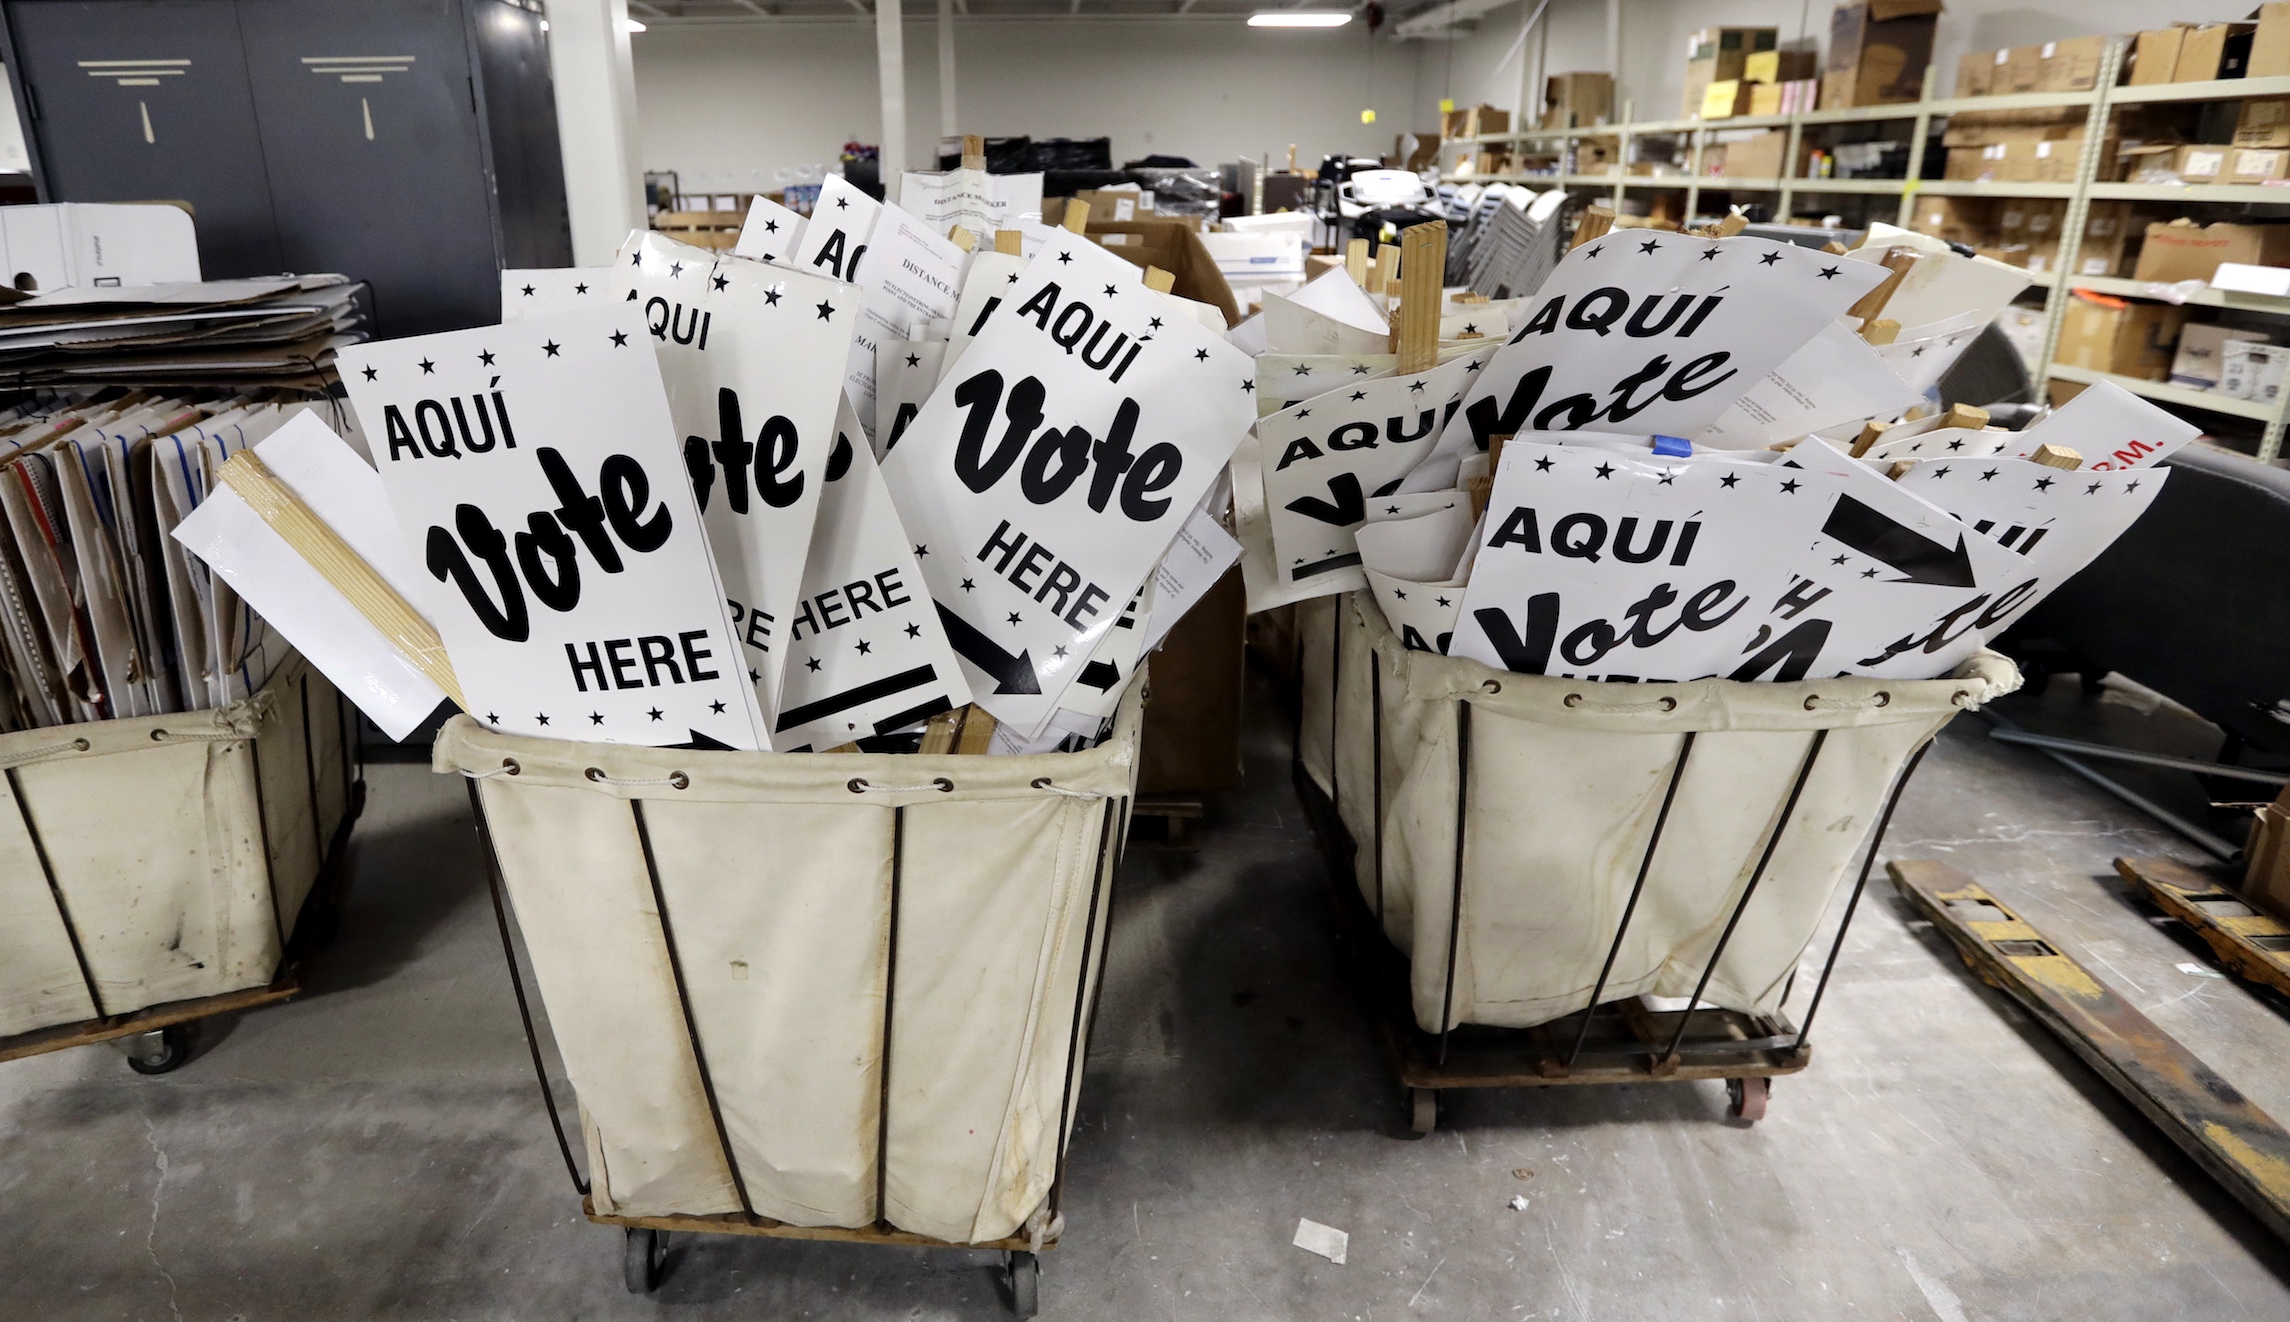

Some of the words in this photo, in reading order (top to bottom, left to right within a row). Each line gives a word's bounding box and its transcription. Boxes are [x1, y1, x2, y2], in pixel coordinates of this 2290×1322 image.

[934, 192, 973, 205] DISTANCE
[974, 194, 1007, 208] MARKER
[902, 259, 950, 295] DISTANCE
[1507, 285, 1730, 346] AQUÍ
[1016, 281, 1153, 384] AQUÍ
[384, 375, 517, 461] AQUÍ
[1466, 351, 1738, 451] Vote
[684, 387, 804, 515] te
[954, 369, 1183, 522] Vote
[426, 447, 672, 642] Vote
[977, 519, 1110, 634] HERE
[1487, 507, 1703, 566] AQUÍ
[726, 598, 775, 653] RE
[791, 567, 912, 641] HERE
[1474, 580, 1749, 675] Vote
[565, 629, 719, 692] HERE
